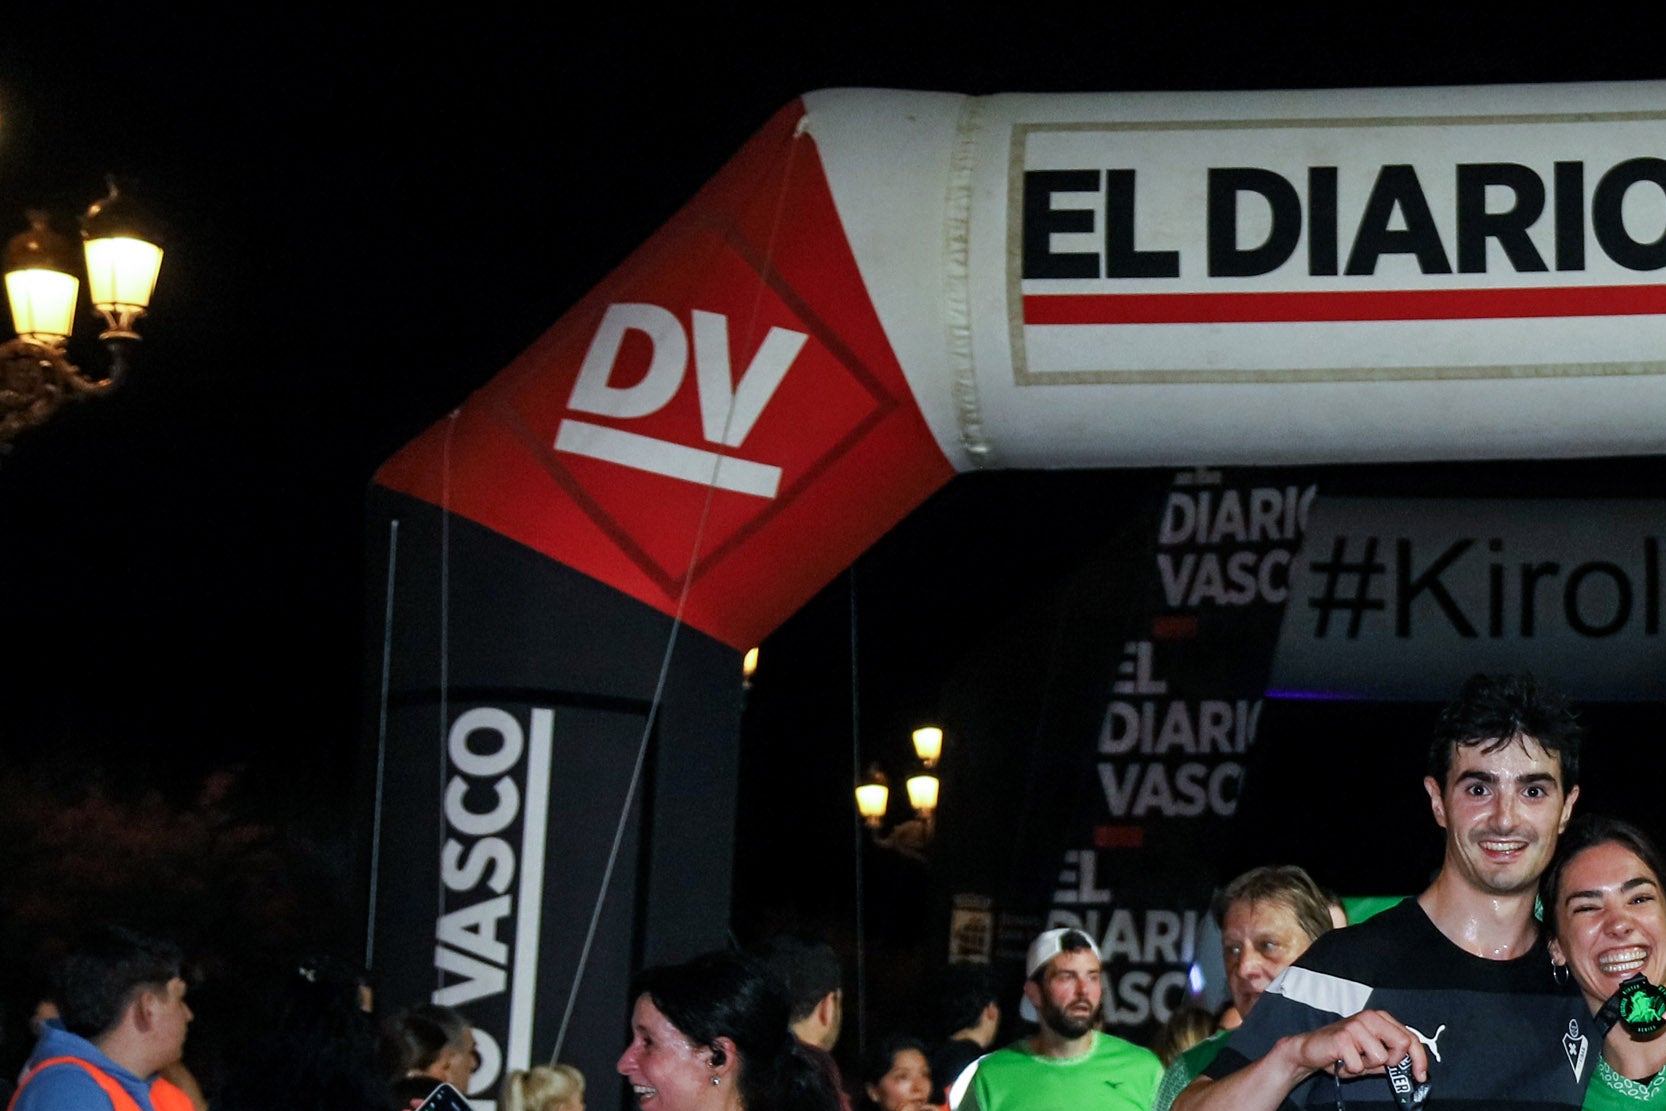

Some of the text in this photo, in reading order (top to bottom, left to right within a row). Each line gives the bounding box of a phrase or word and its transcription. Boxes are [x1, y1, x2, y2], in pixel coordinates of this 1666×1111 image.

[1021, 168, 1181, 279] EL
[566, 302, 809, 449] DV
[1098, 700, 1264, 754] DIARI
[430, 706, 525, 1007] VASCO
